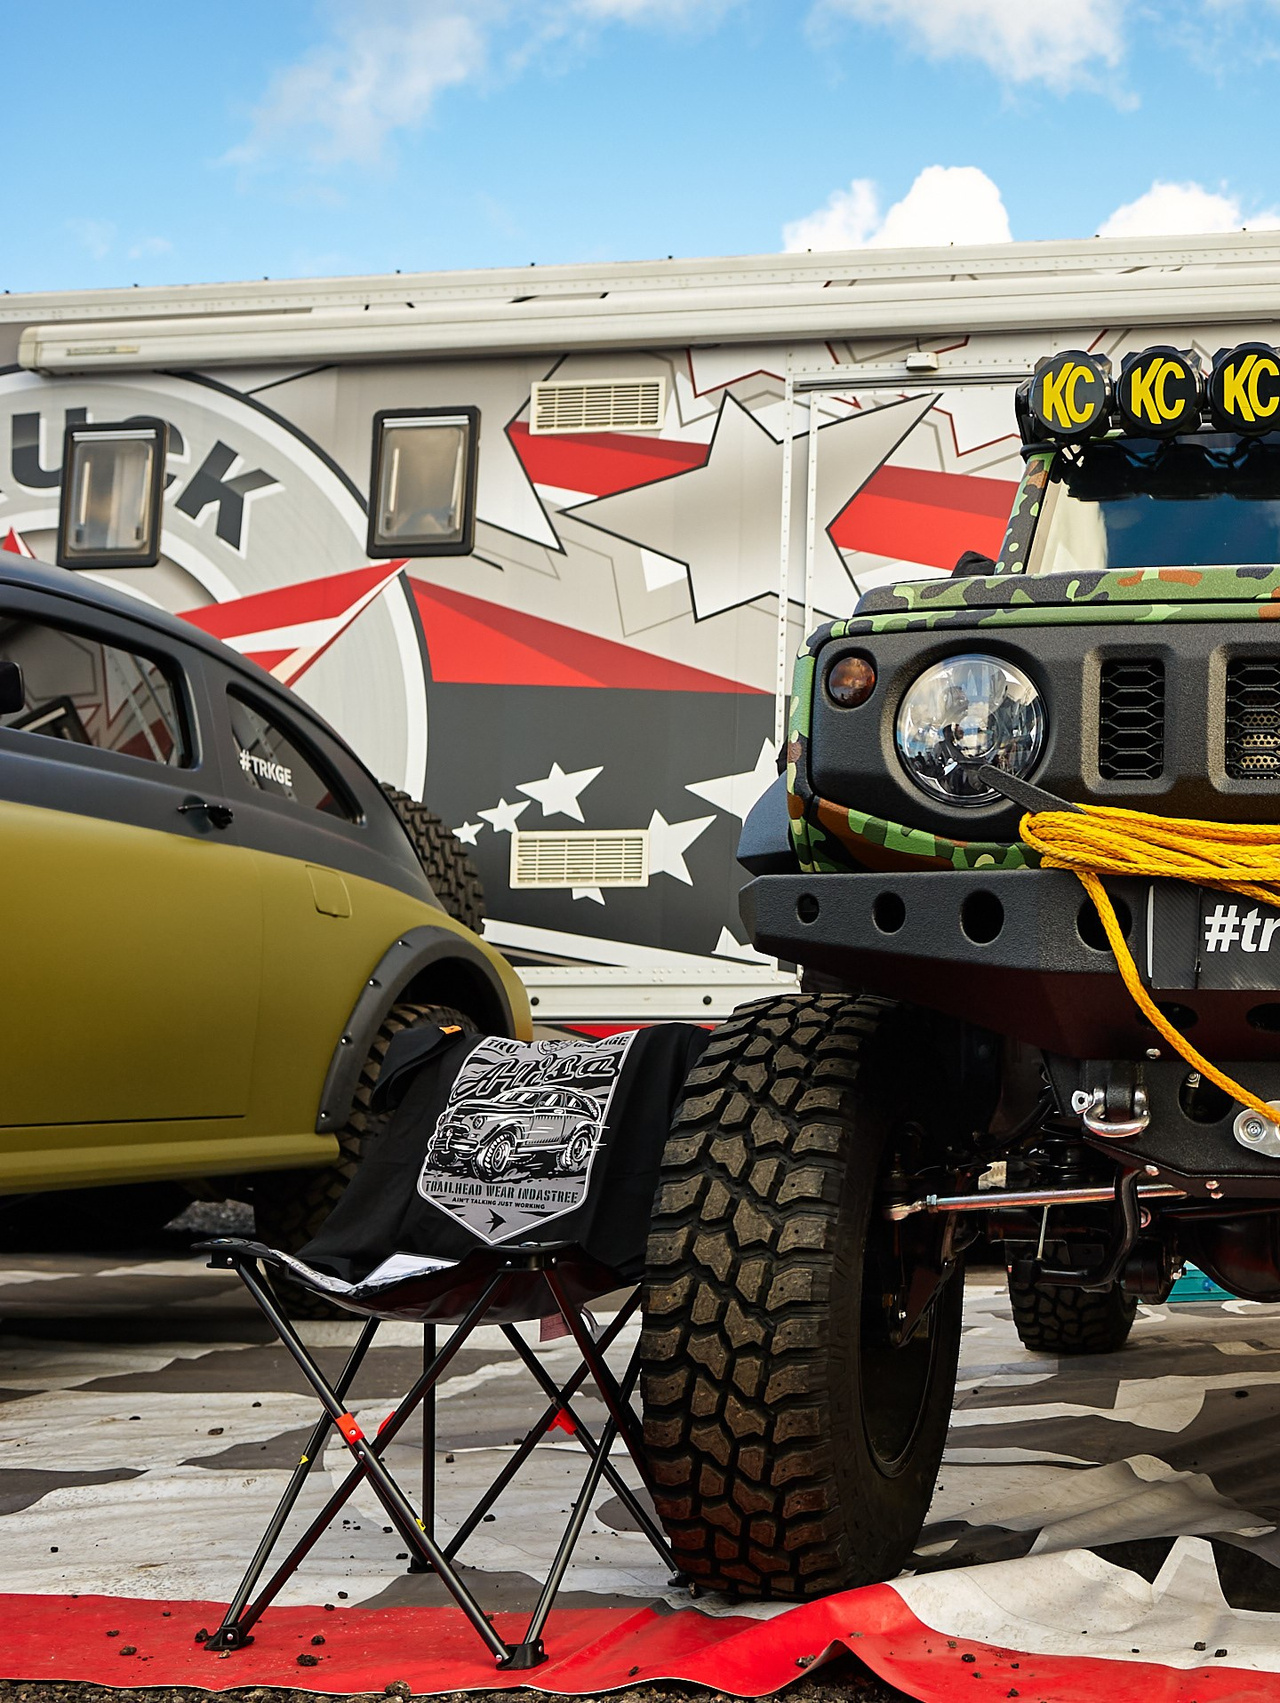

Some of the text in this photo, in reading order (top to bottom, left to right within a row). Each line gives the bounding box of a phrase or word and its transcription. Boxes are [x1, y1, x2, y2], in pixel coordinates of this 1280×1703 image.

[1043, 363, 1094, 427] KC
[1132, 358, 1185, 424] KC
[1224, 355, 1279, 421] KC
[240, 749, 293, 787] #TRKGE
[425, 1180, 579, 1203] TRAILHEAD WEAR INDASTREE
[470, 1198, 496, 1206] TALKING
